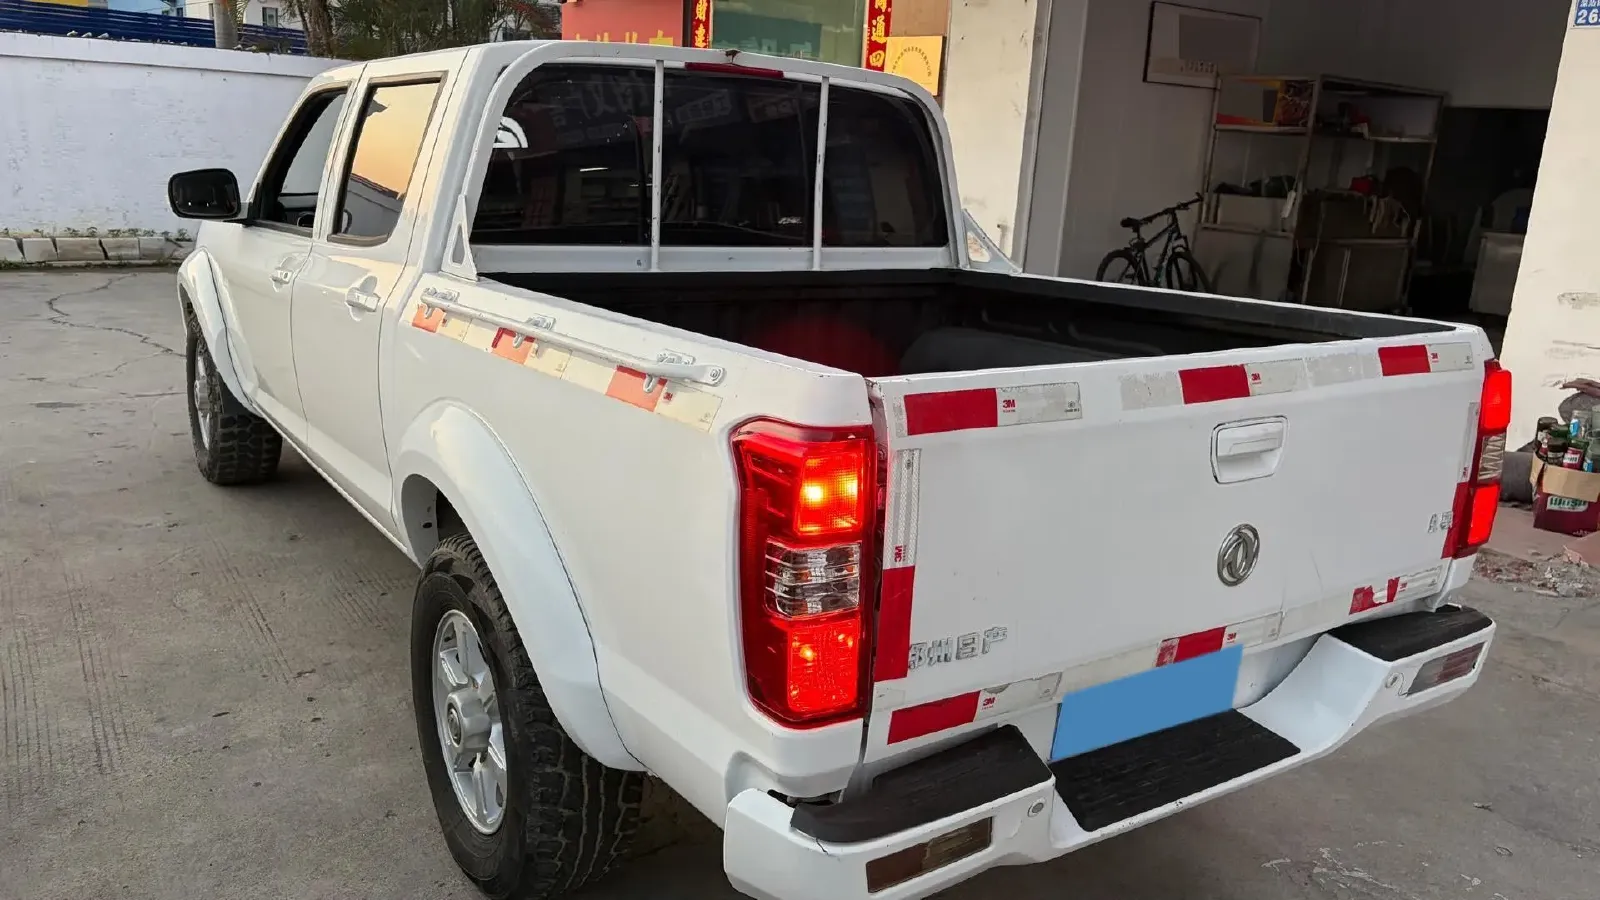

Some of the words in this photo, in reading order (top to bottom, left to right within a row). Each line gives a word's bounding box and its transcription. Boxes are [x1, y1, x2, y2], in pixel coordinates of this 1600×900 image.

[1576, 9, 1600, 24] 26
[1002, 399, 1016, 408] 3M
[894, 546, 903, 562] 3M
[982, 696, 996, 707] 3M
